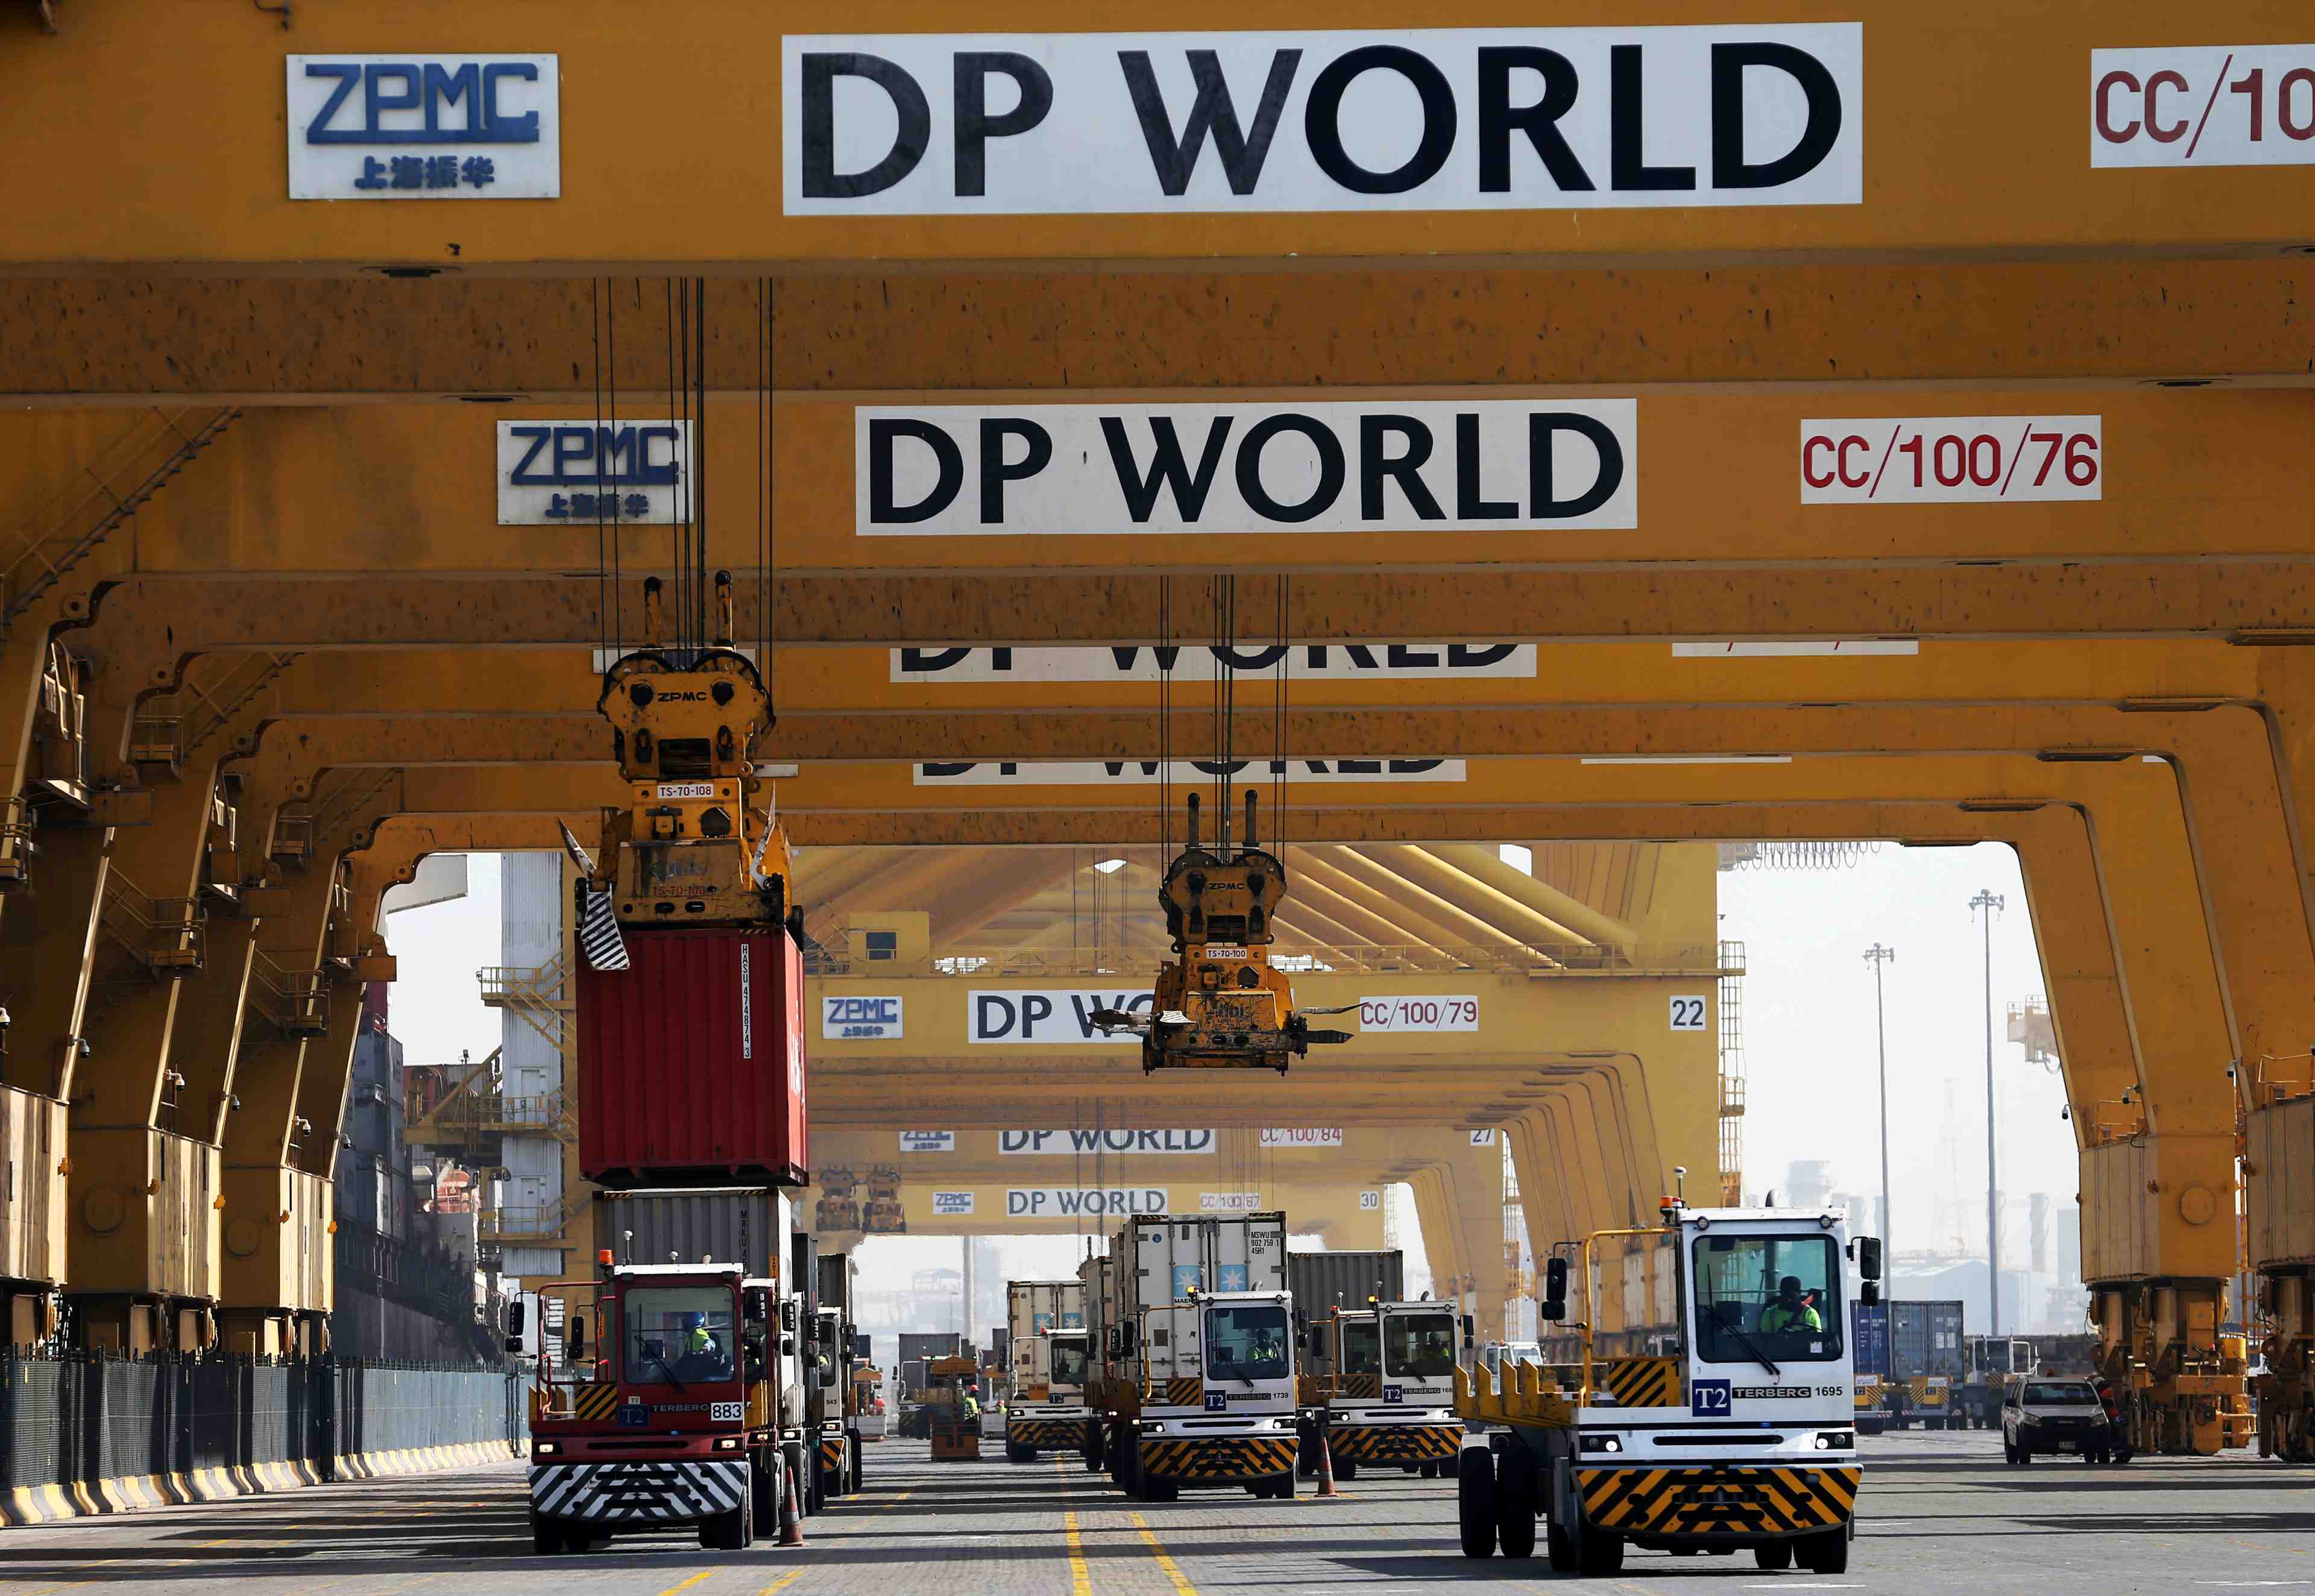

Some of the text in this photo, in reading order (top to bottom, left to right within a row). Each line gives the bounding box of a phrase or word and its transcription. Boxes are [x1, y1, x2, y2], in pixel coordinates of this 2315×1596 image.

[306, 63, 538, 144] ZPMC
[801, 41, 1842, 198] DP WORLD
[354, 156, 495, 189] 上海振华
[511, 427, 679, 485] ZPMC
[1803, 423, 2098, 498] CC/100/76
[869, 413, 1624, 524] DP WORLD
[658, 691, 708, 702] ZPMC
[660, 786, 712, 796] TS-70-108
[1208, 949, 1246, 958] TS-70-100
[828, 999, 897, 1023] ZPMC
[977, 995, 1052, 1038] DP
[1361, 998, 1477, 1029] CC/100/79
[1672, 999, 1703, 1026] 22
[745, 1048, 750, 1057] 3
[1069, 1129, 1211, 1151] WORLD
[1009, 1190, 1165, 1214] DP WORLD
[1361, 1193, 1378, 1207] 30
[1206, 1394, 1224, 1407] T2
[1385, 1389, 1400, 1400] T2
[1695, 1386, 1843, 1409] T2 TERBERG 1695
[622, 1403, 742, 1423] T2 TERBERG 883
